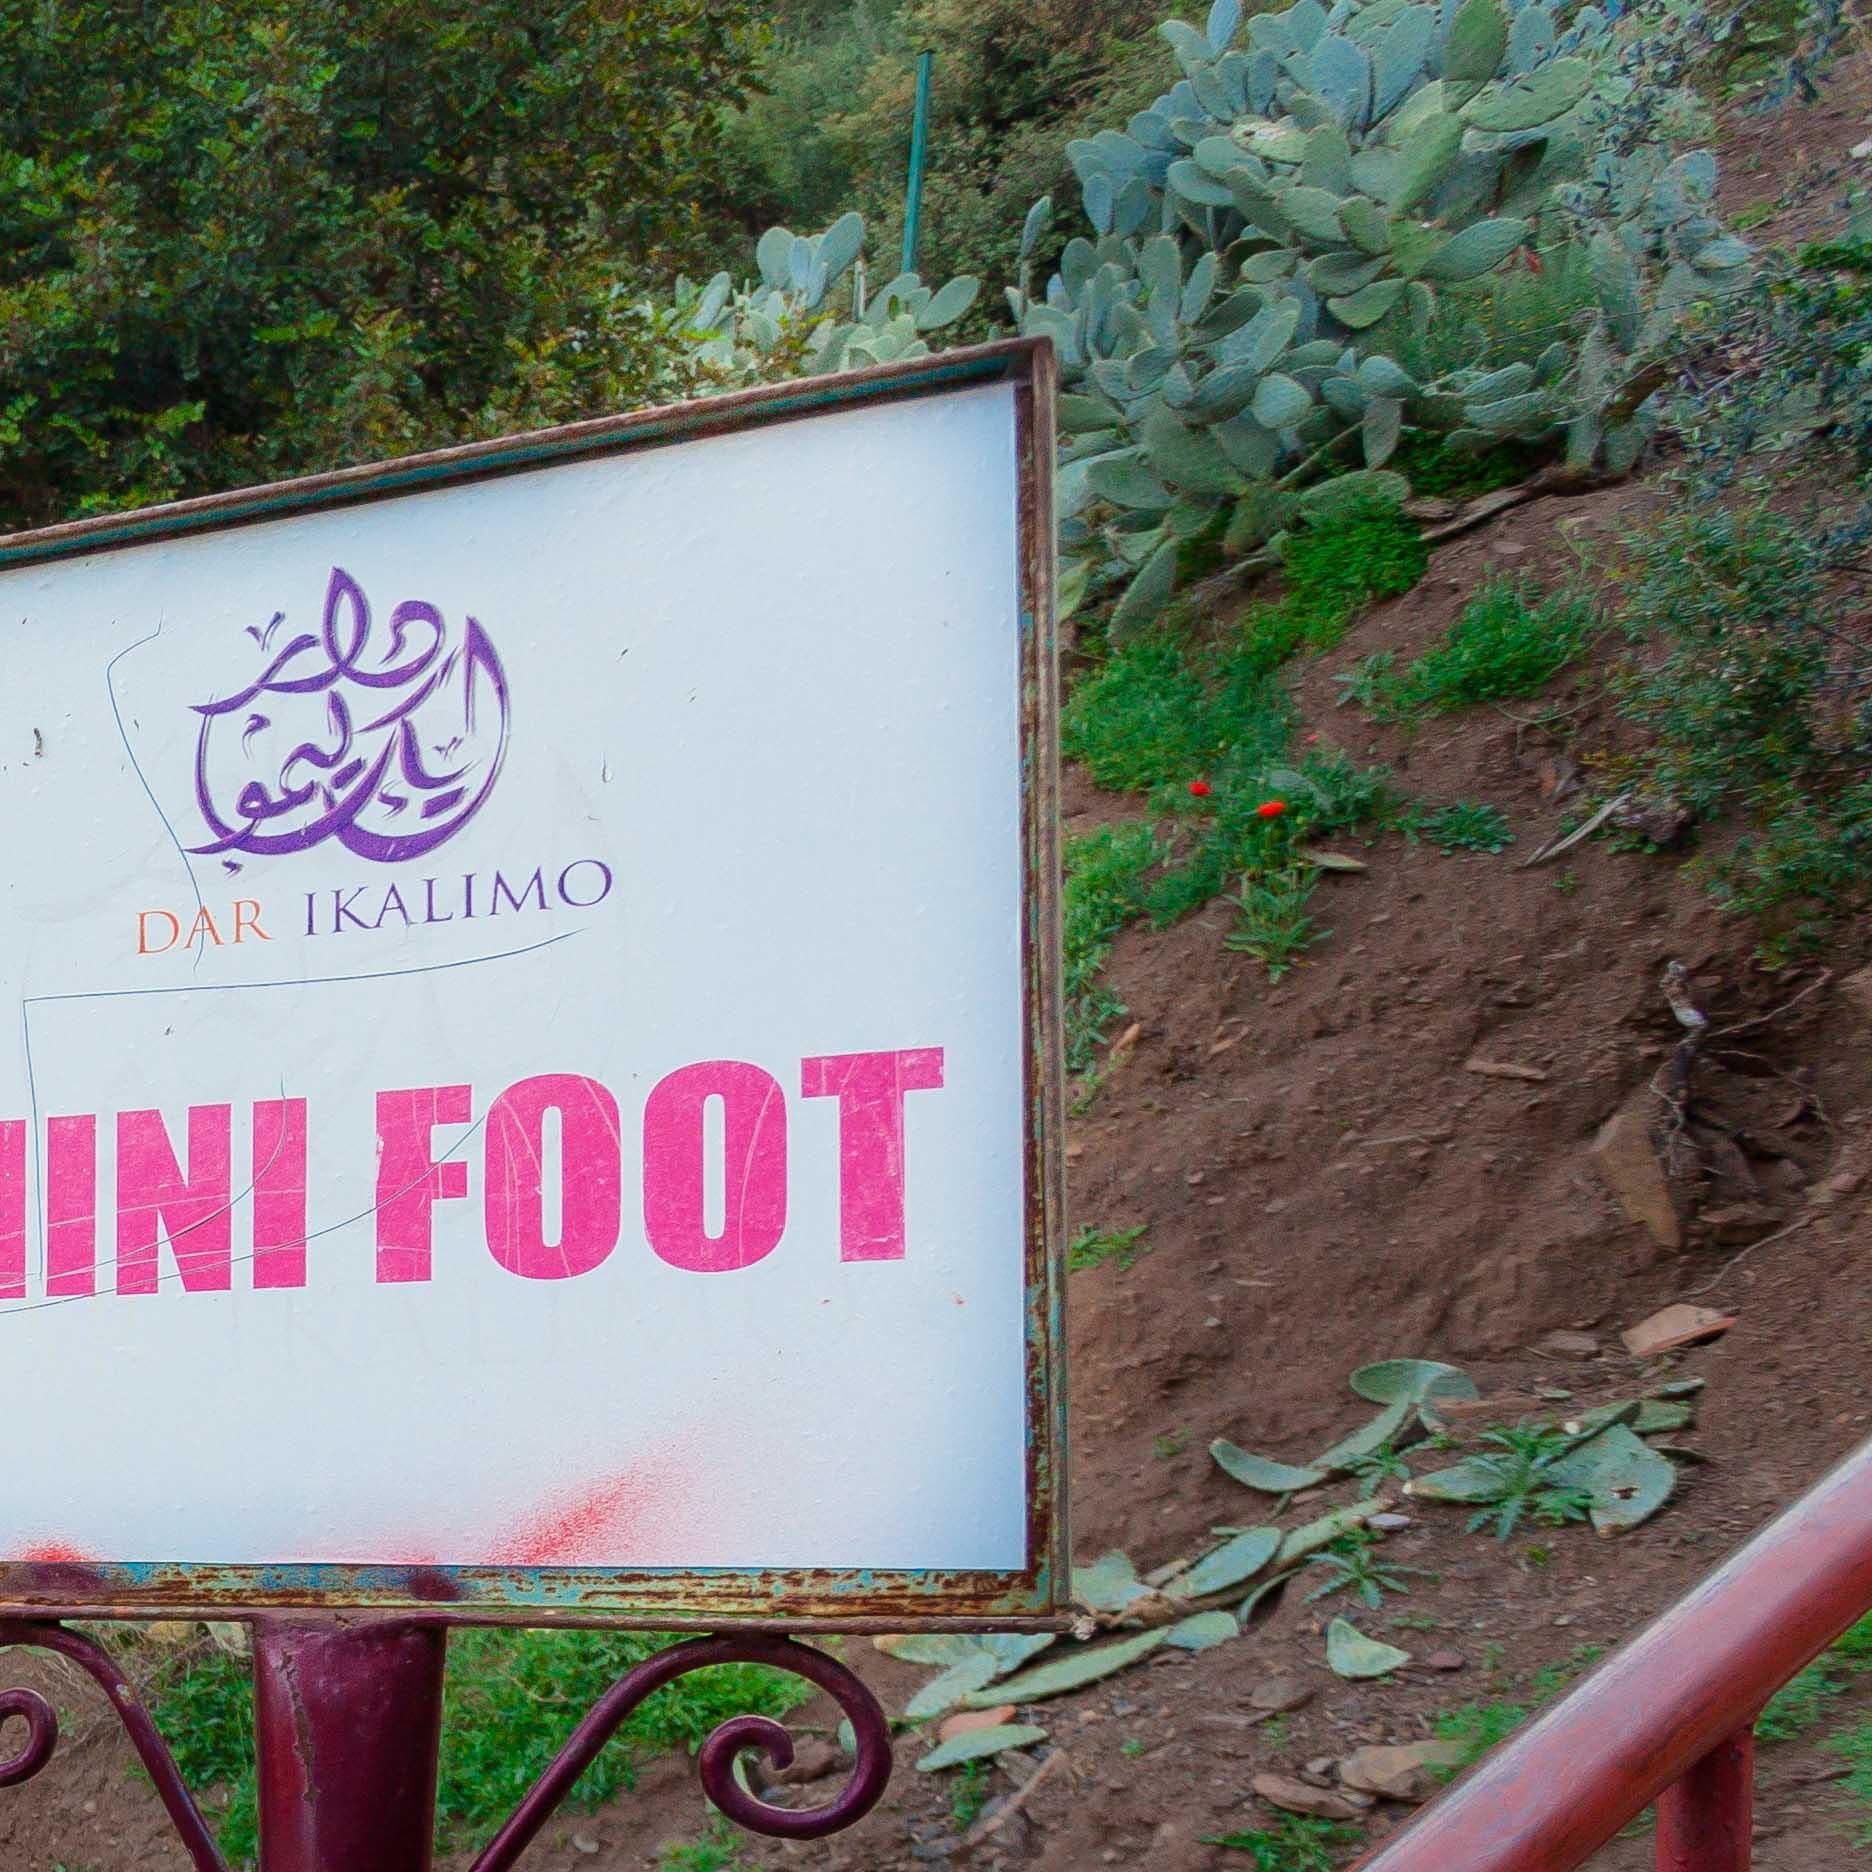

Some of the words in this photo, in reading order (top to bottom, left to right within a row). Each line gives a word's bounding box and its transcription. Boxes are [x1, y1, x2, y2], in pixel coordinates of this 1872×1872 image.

[136, 899, 271, 955] DAR
[304, 859, 613, 937] IKALIMO
[375, 1046, 945, 1284] FOOT
